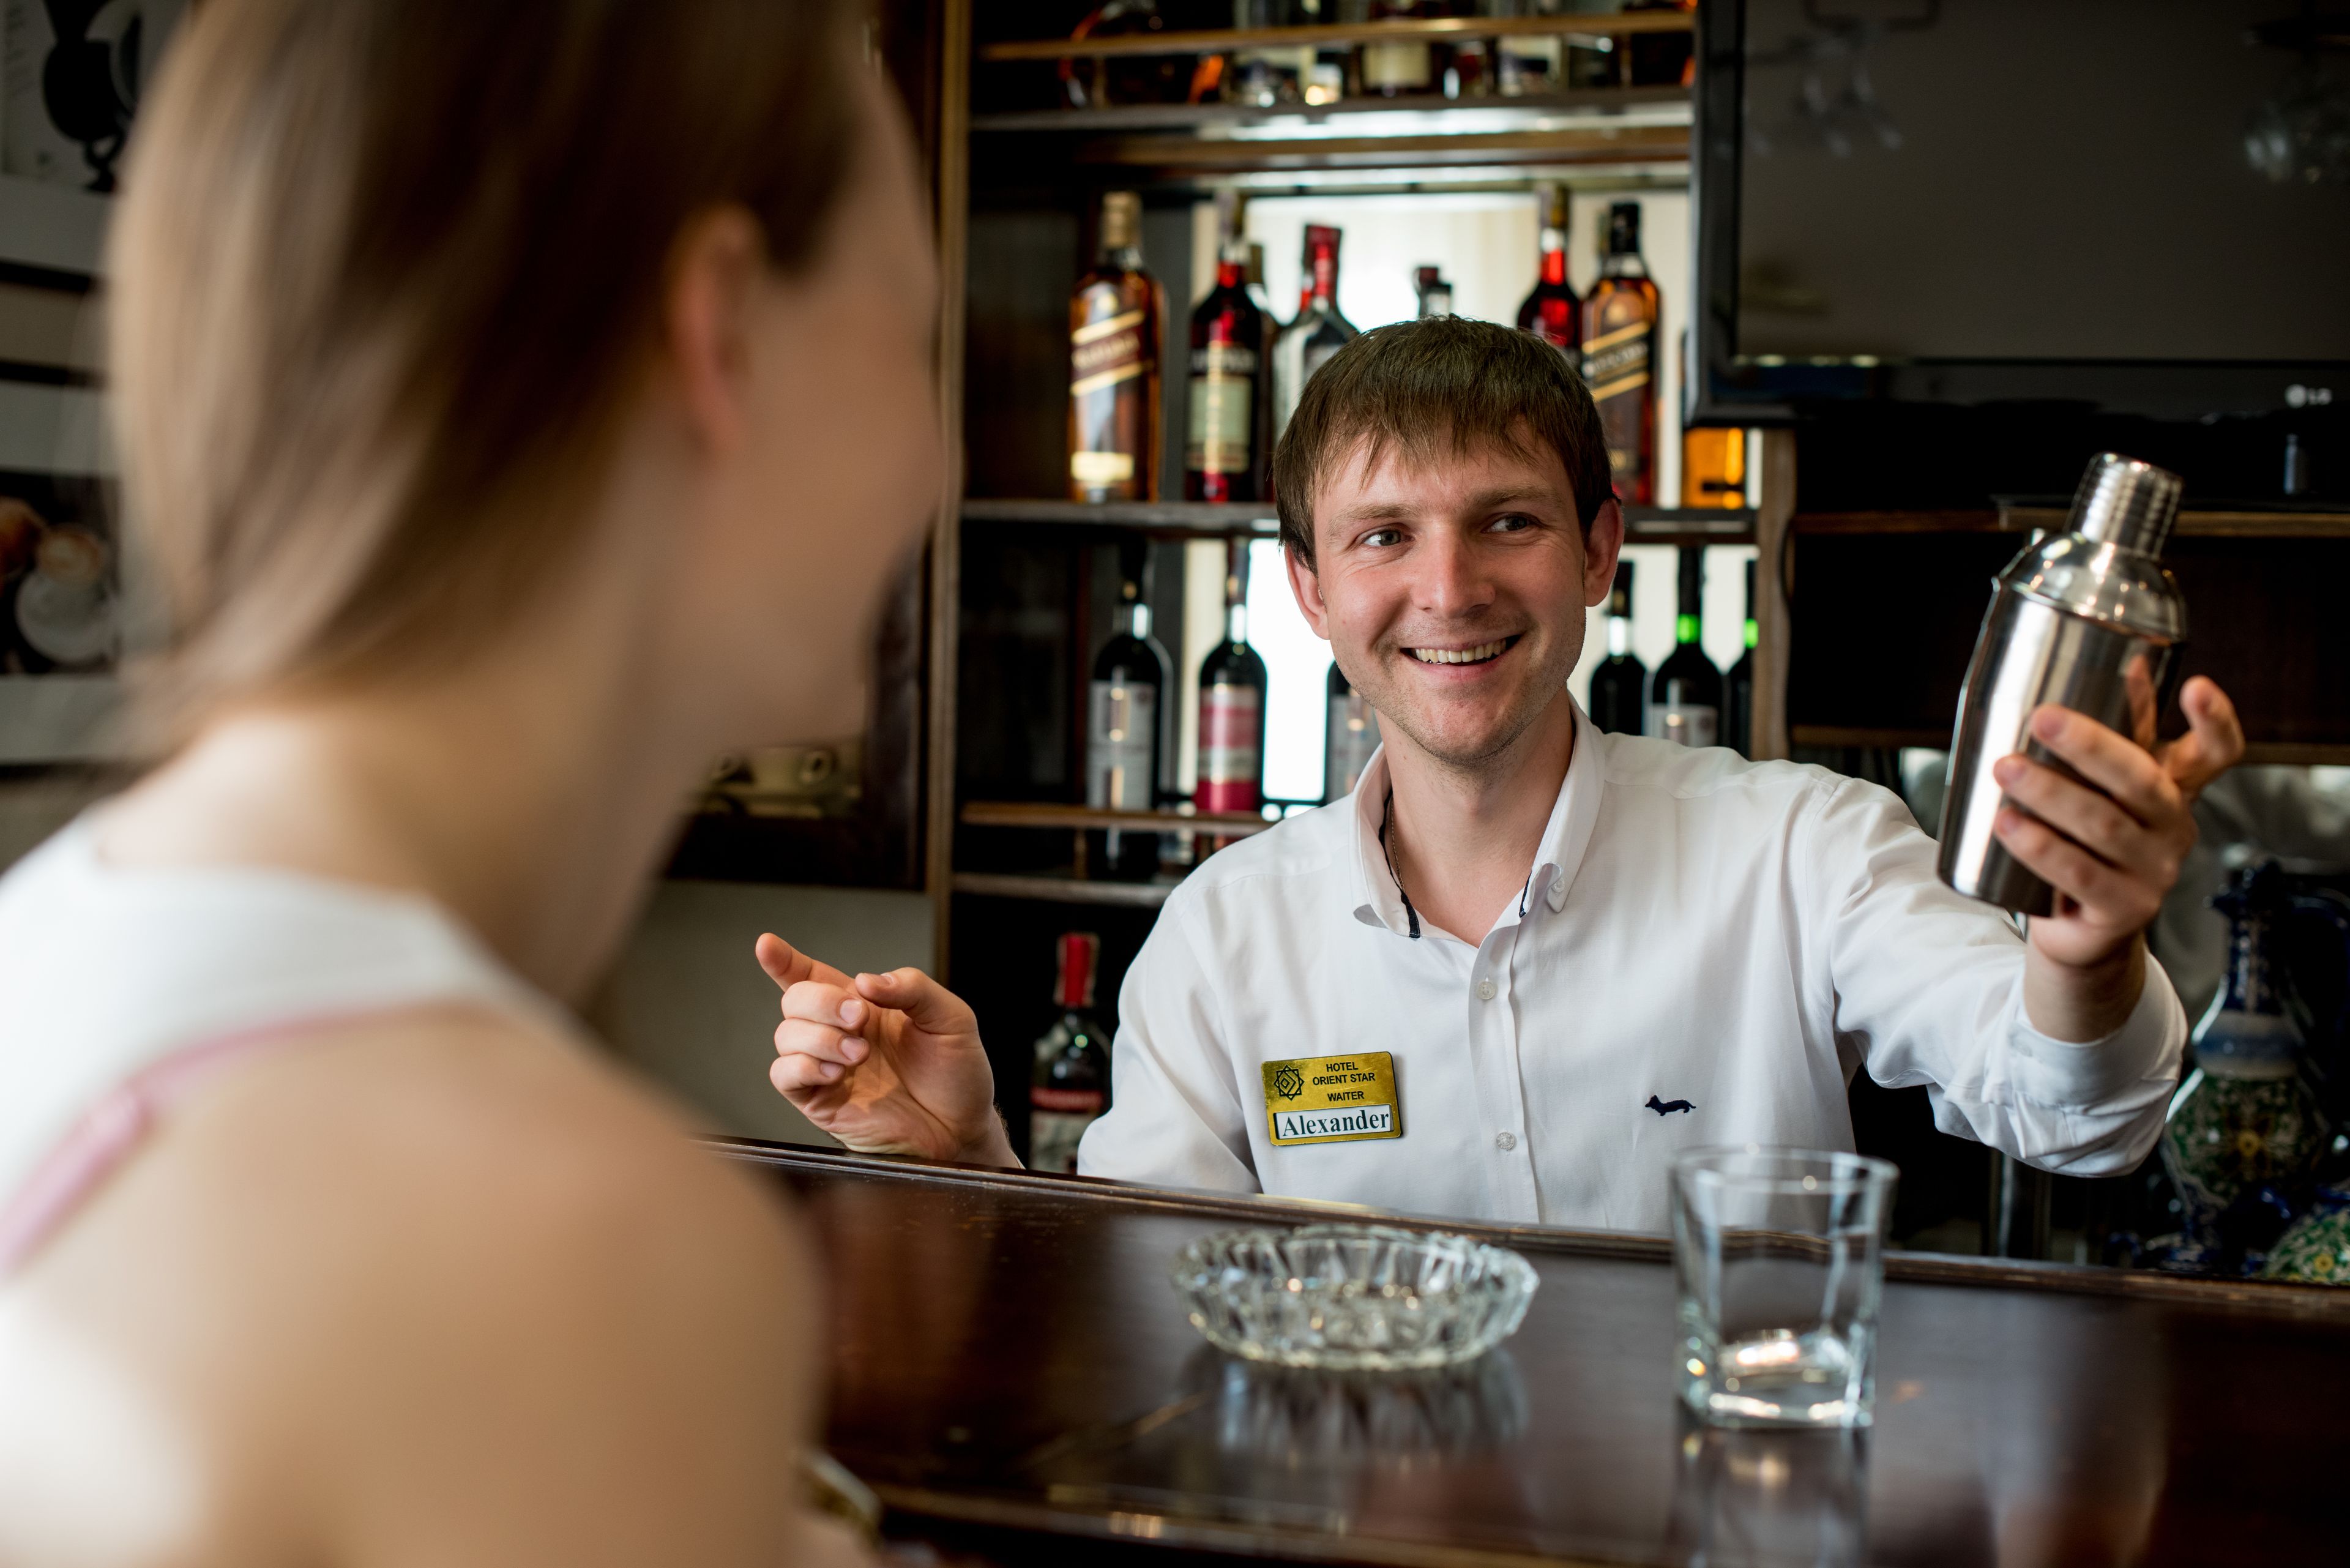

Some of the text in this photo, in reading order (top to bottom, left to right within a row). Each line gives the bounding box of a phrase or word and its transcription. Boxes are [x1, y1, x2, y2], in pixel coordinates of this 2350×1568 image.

[1326, 1062, 1358, 1072] HOTEL
[1312, 1072, 1375, 1085] ORIENT STAR
[1327, 1091, 1364, 1102] WAITER
[1283, 1110, 1389, 1137] Alexander
